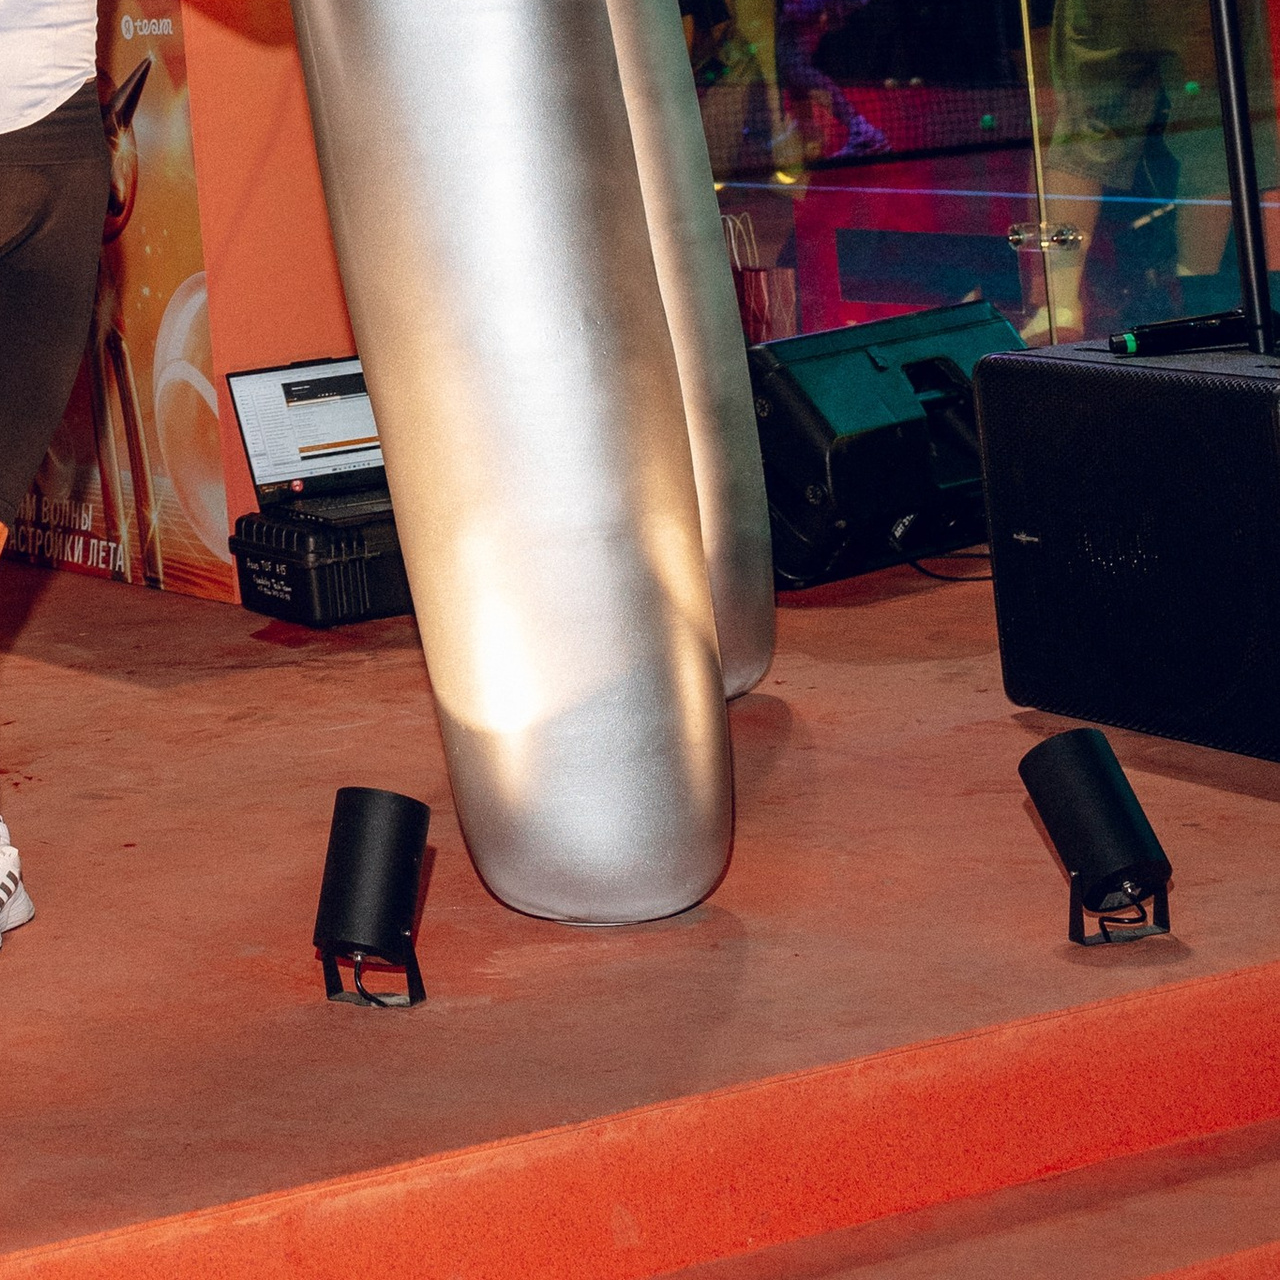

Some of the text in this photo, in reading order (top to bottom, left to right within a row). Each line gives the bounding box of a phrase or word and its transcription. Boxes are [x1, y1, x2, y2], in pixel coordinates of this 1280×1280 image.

[134, 18, 174, 36] team
[41, 497, 93, 532] ВОЛНЫ
[5, 523, 125, 573] АСТРОЙКИ ЛЕТА
